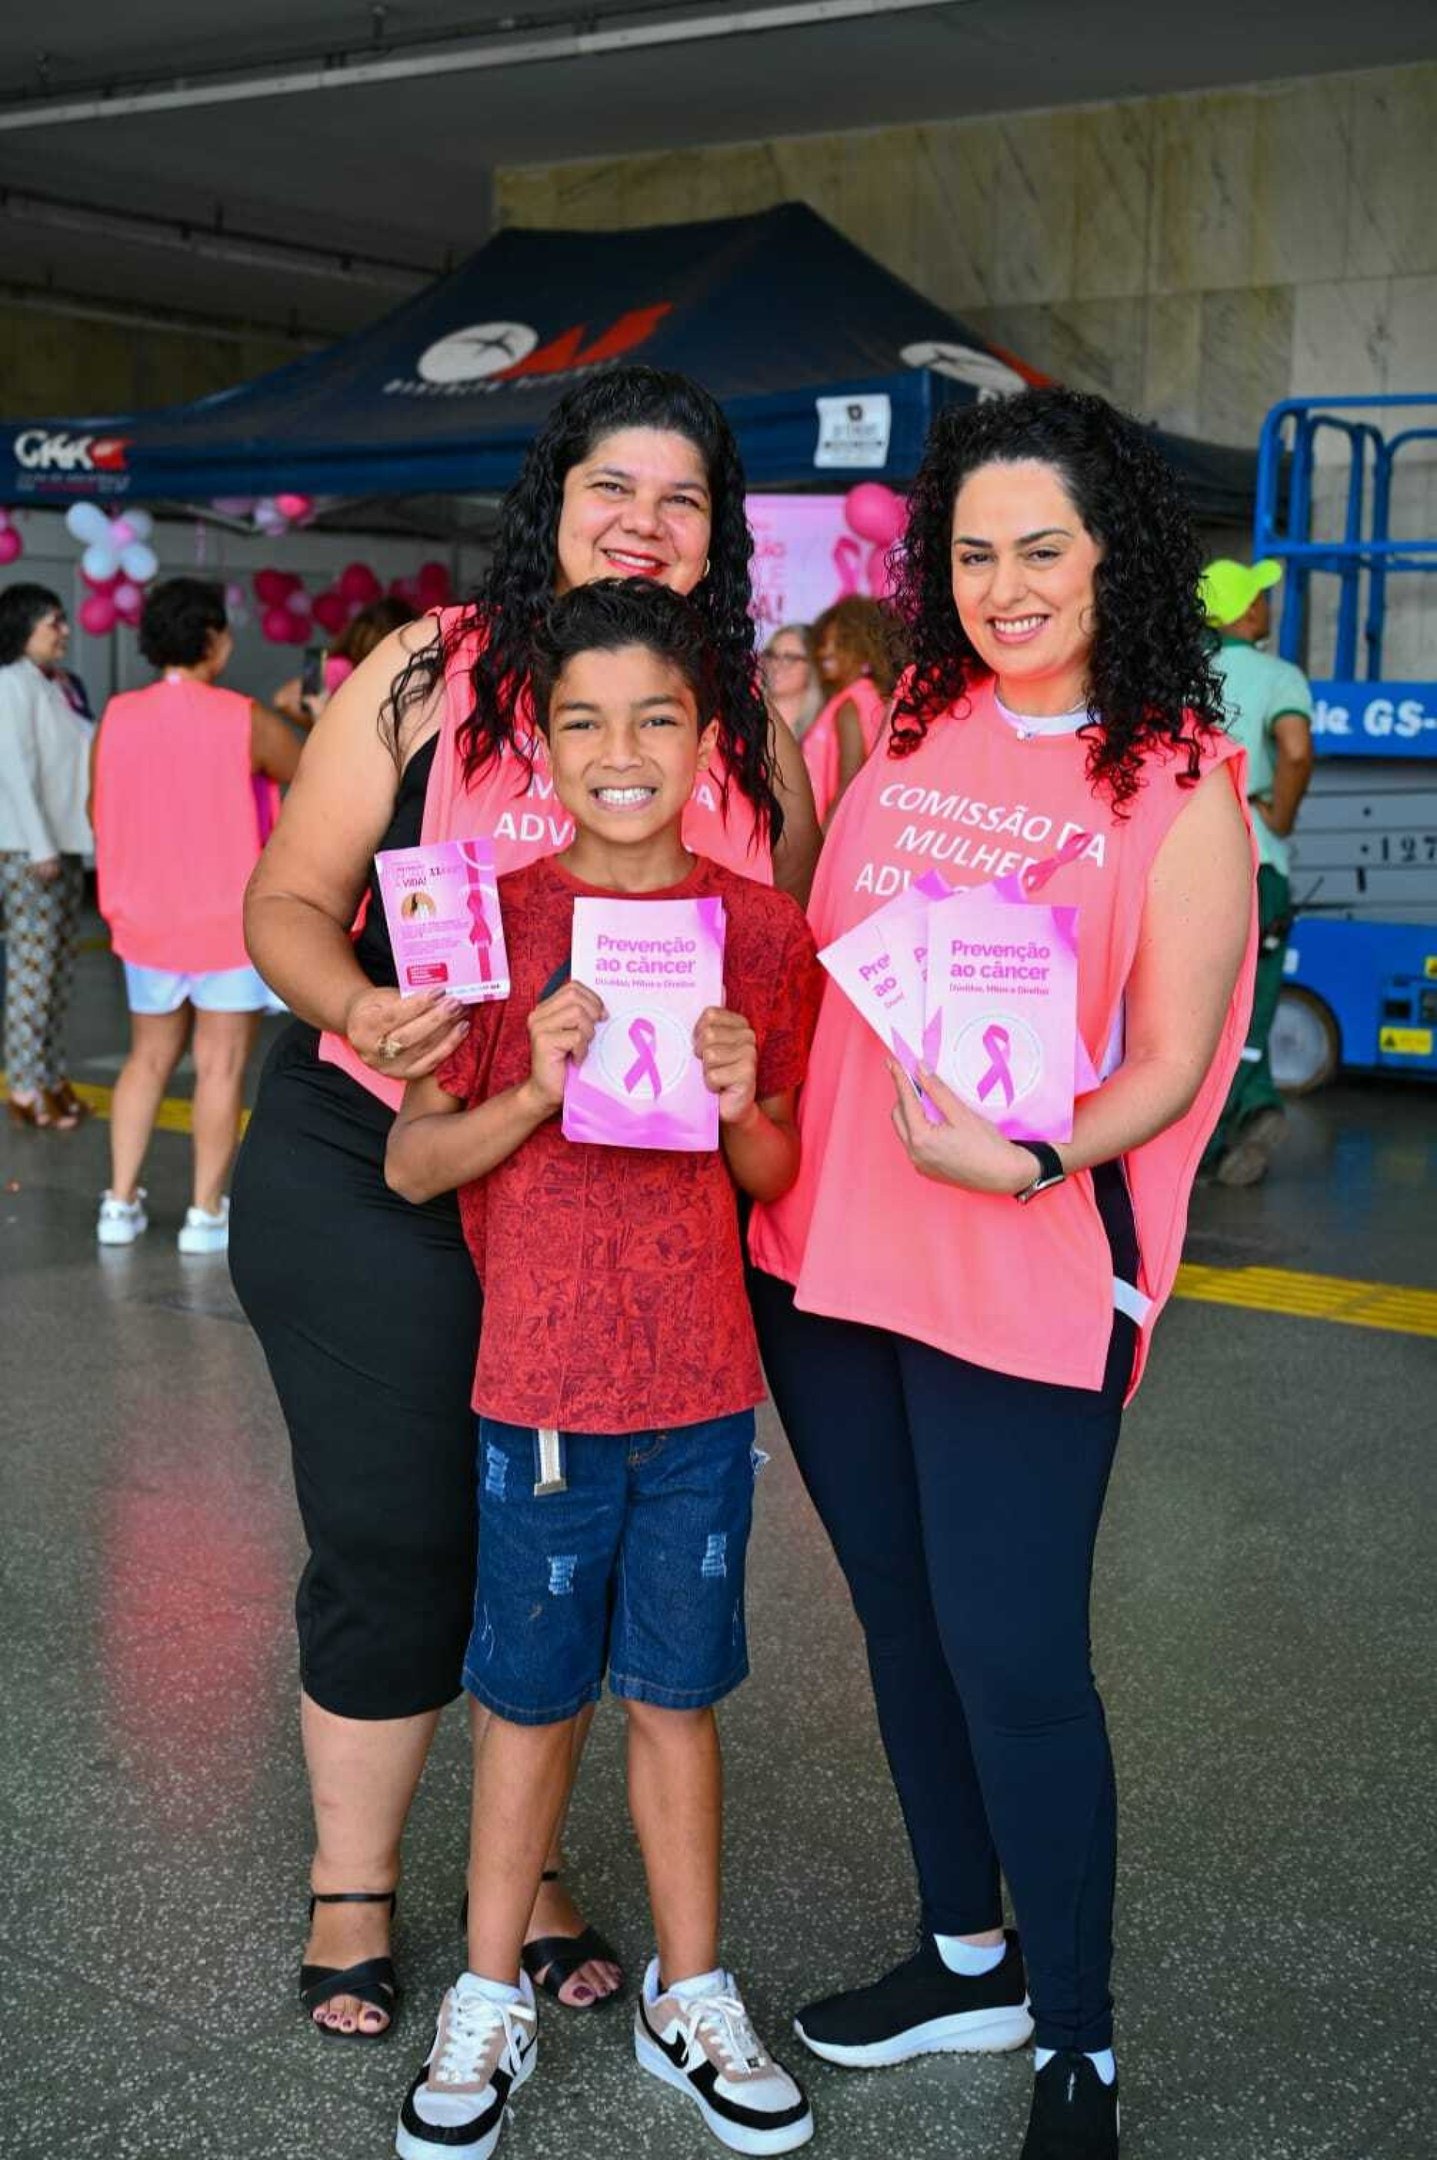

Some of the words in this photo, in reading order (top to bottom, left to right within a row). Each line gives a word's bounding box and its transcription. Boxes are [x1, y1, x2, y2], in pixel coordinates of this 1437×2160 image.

[879, 783, 1051, 843] COMISSÃO
[597, 934, 697, 956] Prevenção
[951, 939, 1050, 962] Prevenção
[595, 957, 622, 973] ao
[626, 955, 697, 974] câncer
[858, 953, 890, 982] Pre
[950, 963, 976, 978] ao
[980, 960, 1050, 980] câncer
[872, 977, 897, 998] ao
